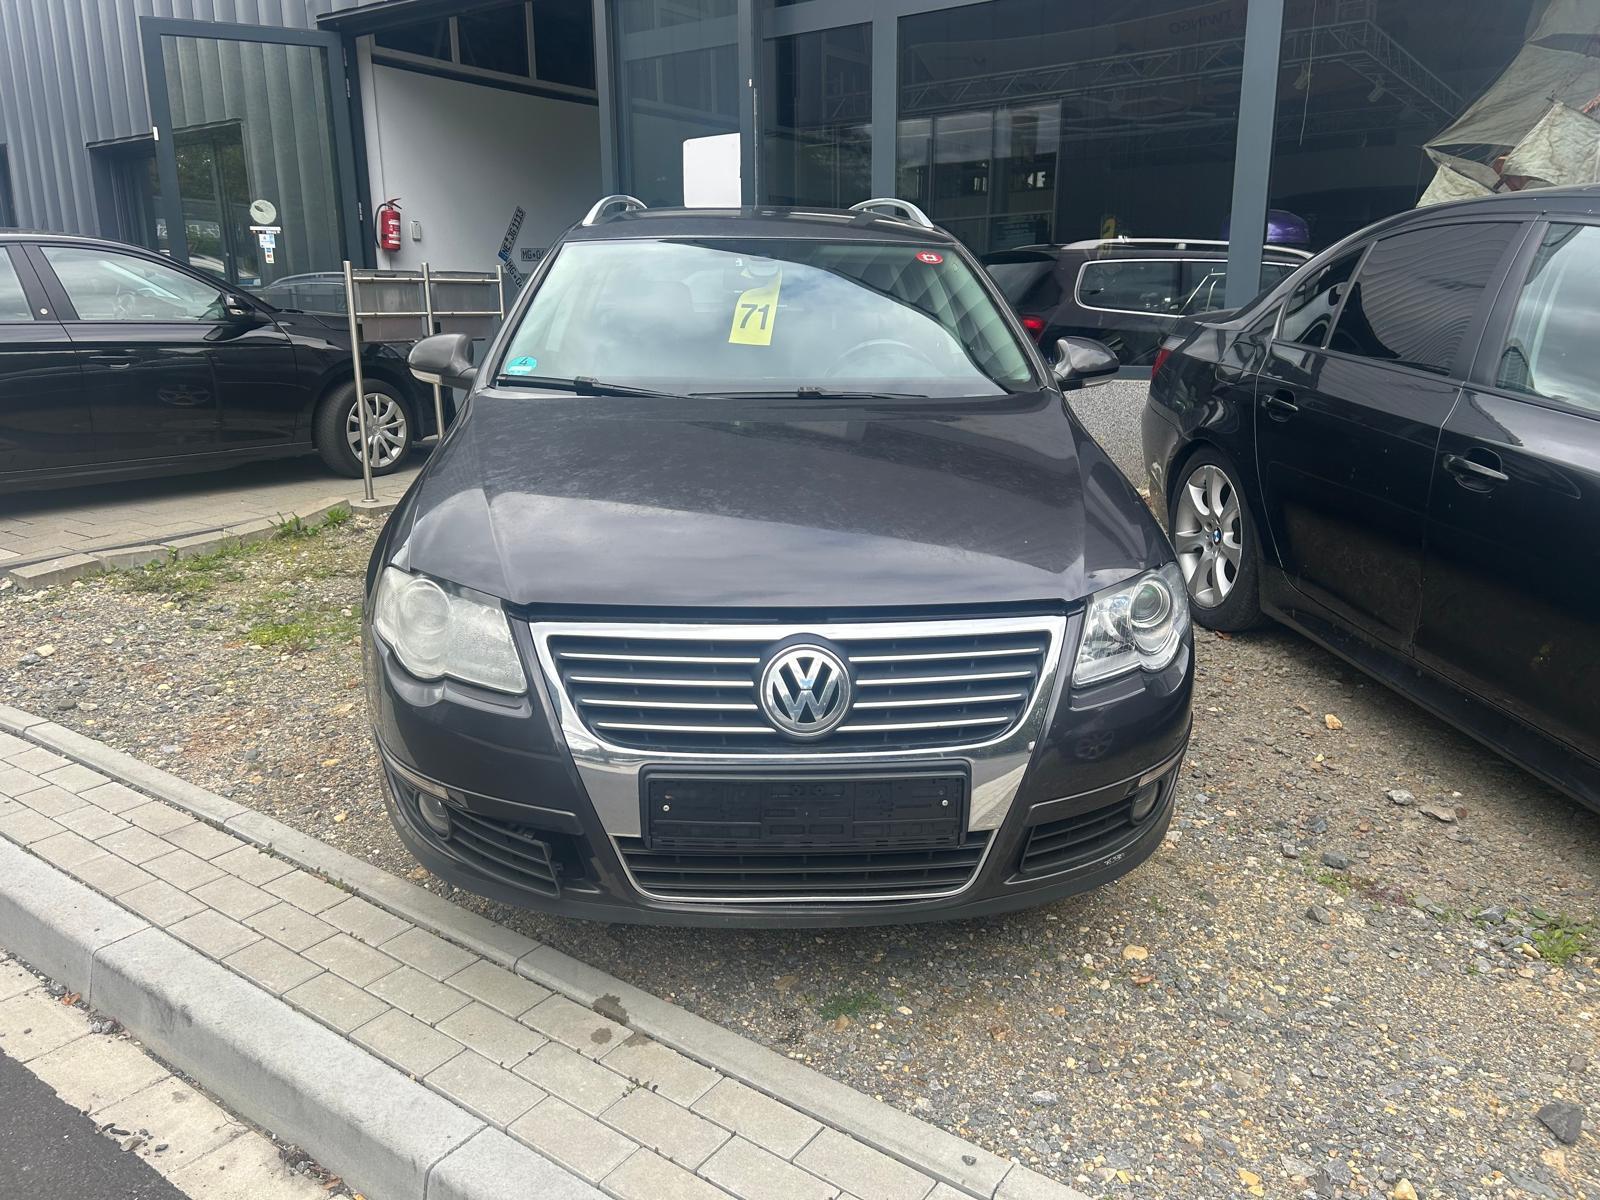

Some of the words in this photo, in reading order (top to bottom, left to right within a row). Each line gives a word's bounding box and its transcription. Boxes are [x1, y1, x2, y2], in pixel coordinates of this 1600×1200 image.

[740, 303, 771, 330] 71
[519, 356, 528, 366] 4
[765, 647, 847, 733] VW
